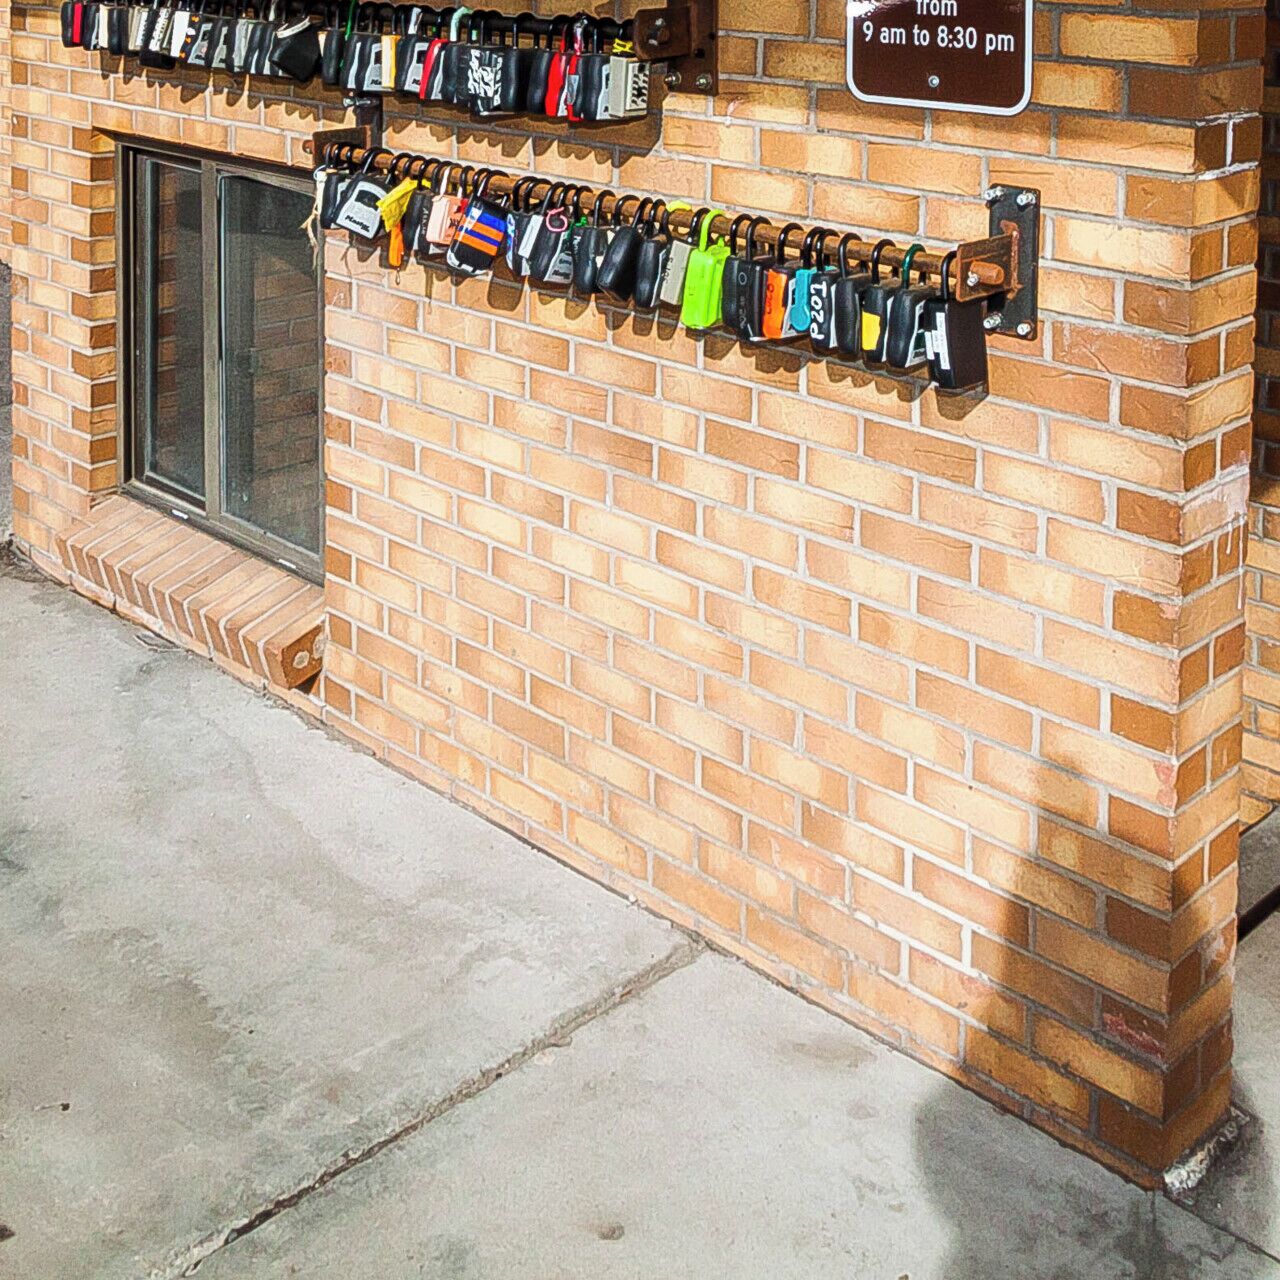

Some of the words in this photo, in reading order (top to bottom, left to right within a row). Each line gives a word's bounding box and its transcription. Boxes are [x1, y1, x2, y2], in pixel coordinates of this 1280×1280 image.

[862, 21, 873, 43] 9
[879, 28, 906, 45] am
[912, 27, 930, 46] to
[937, 26, 978, 50] 8:30
[985, 33, 1015, 55] pm
[810, 281, 827, 340] P201
